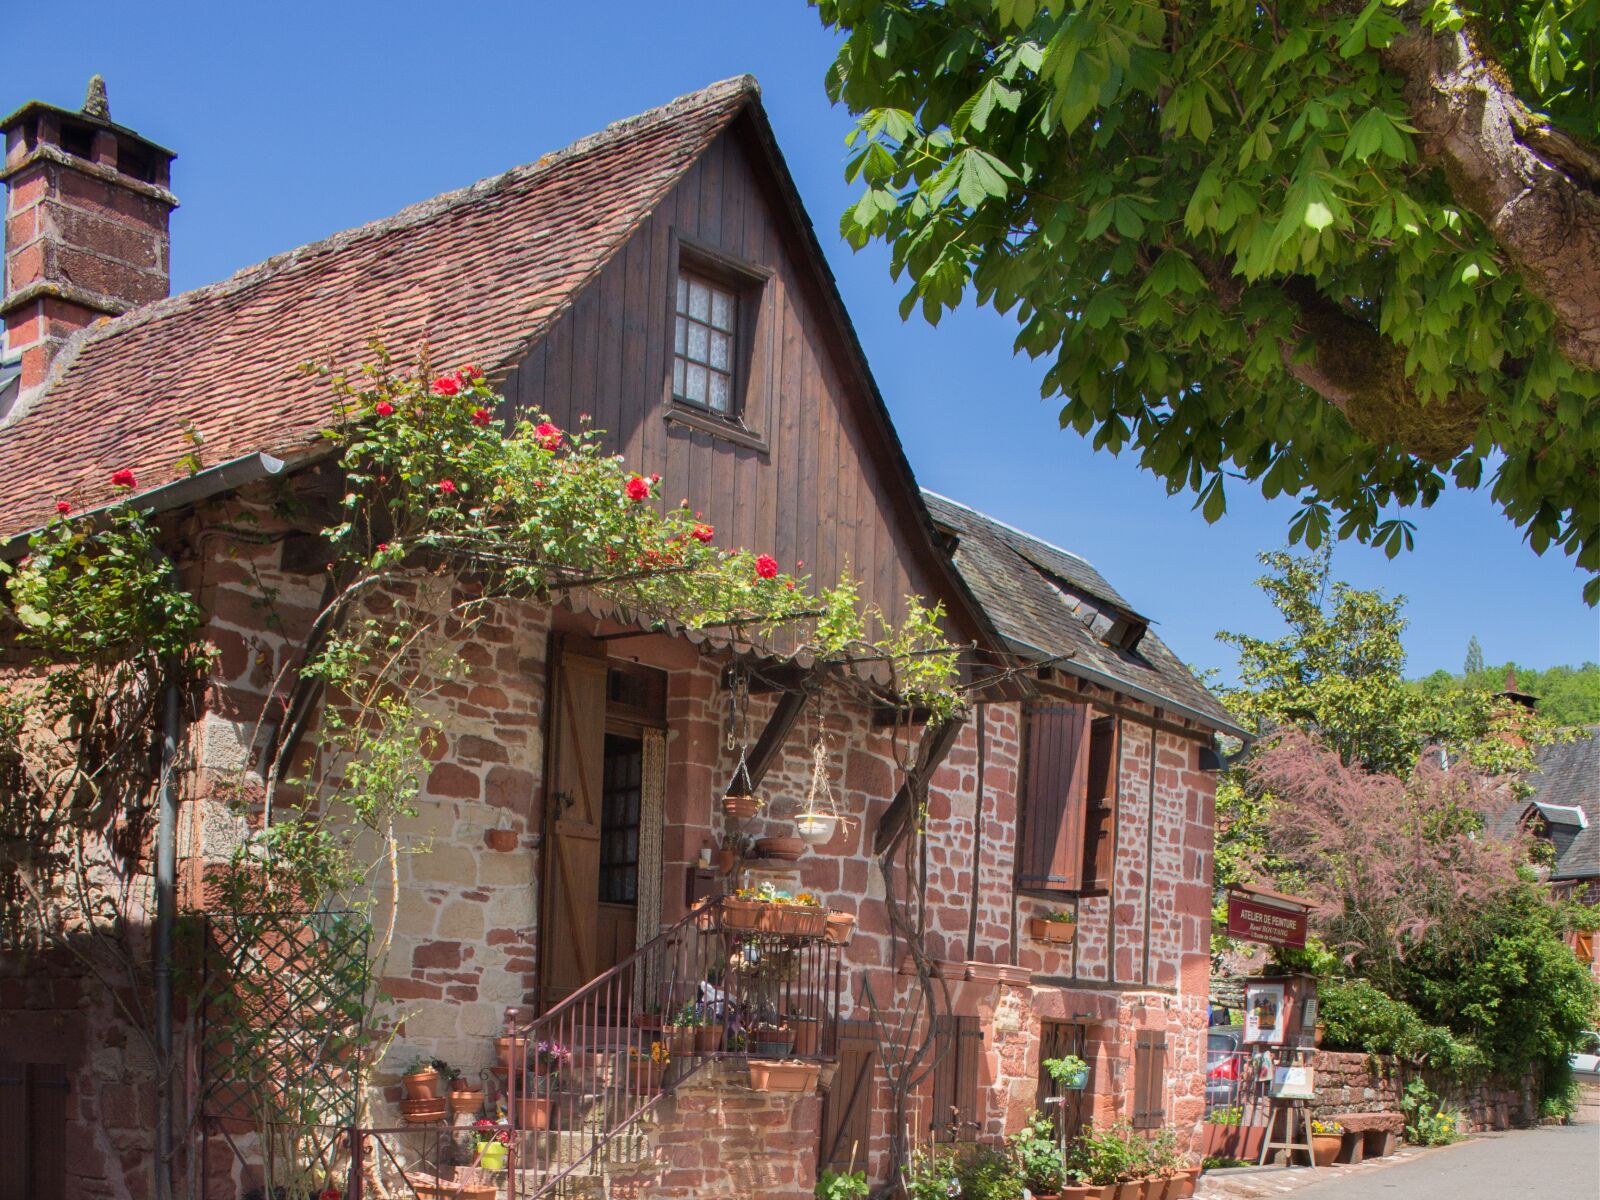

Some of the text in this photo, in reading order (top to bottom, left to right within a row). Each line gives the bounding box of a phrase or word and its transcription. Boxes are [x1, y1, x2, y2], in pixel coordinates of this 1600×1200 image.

[1240, 909, 1297, 930] ATELIER DE PEINTURE
